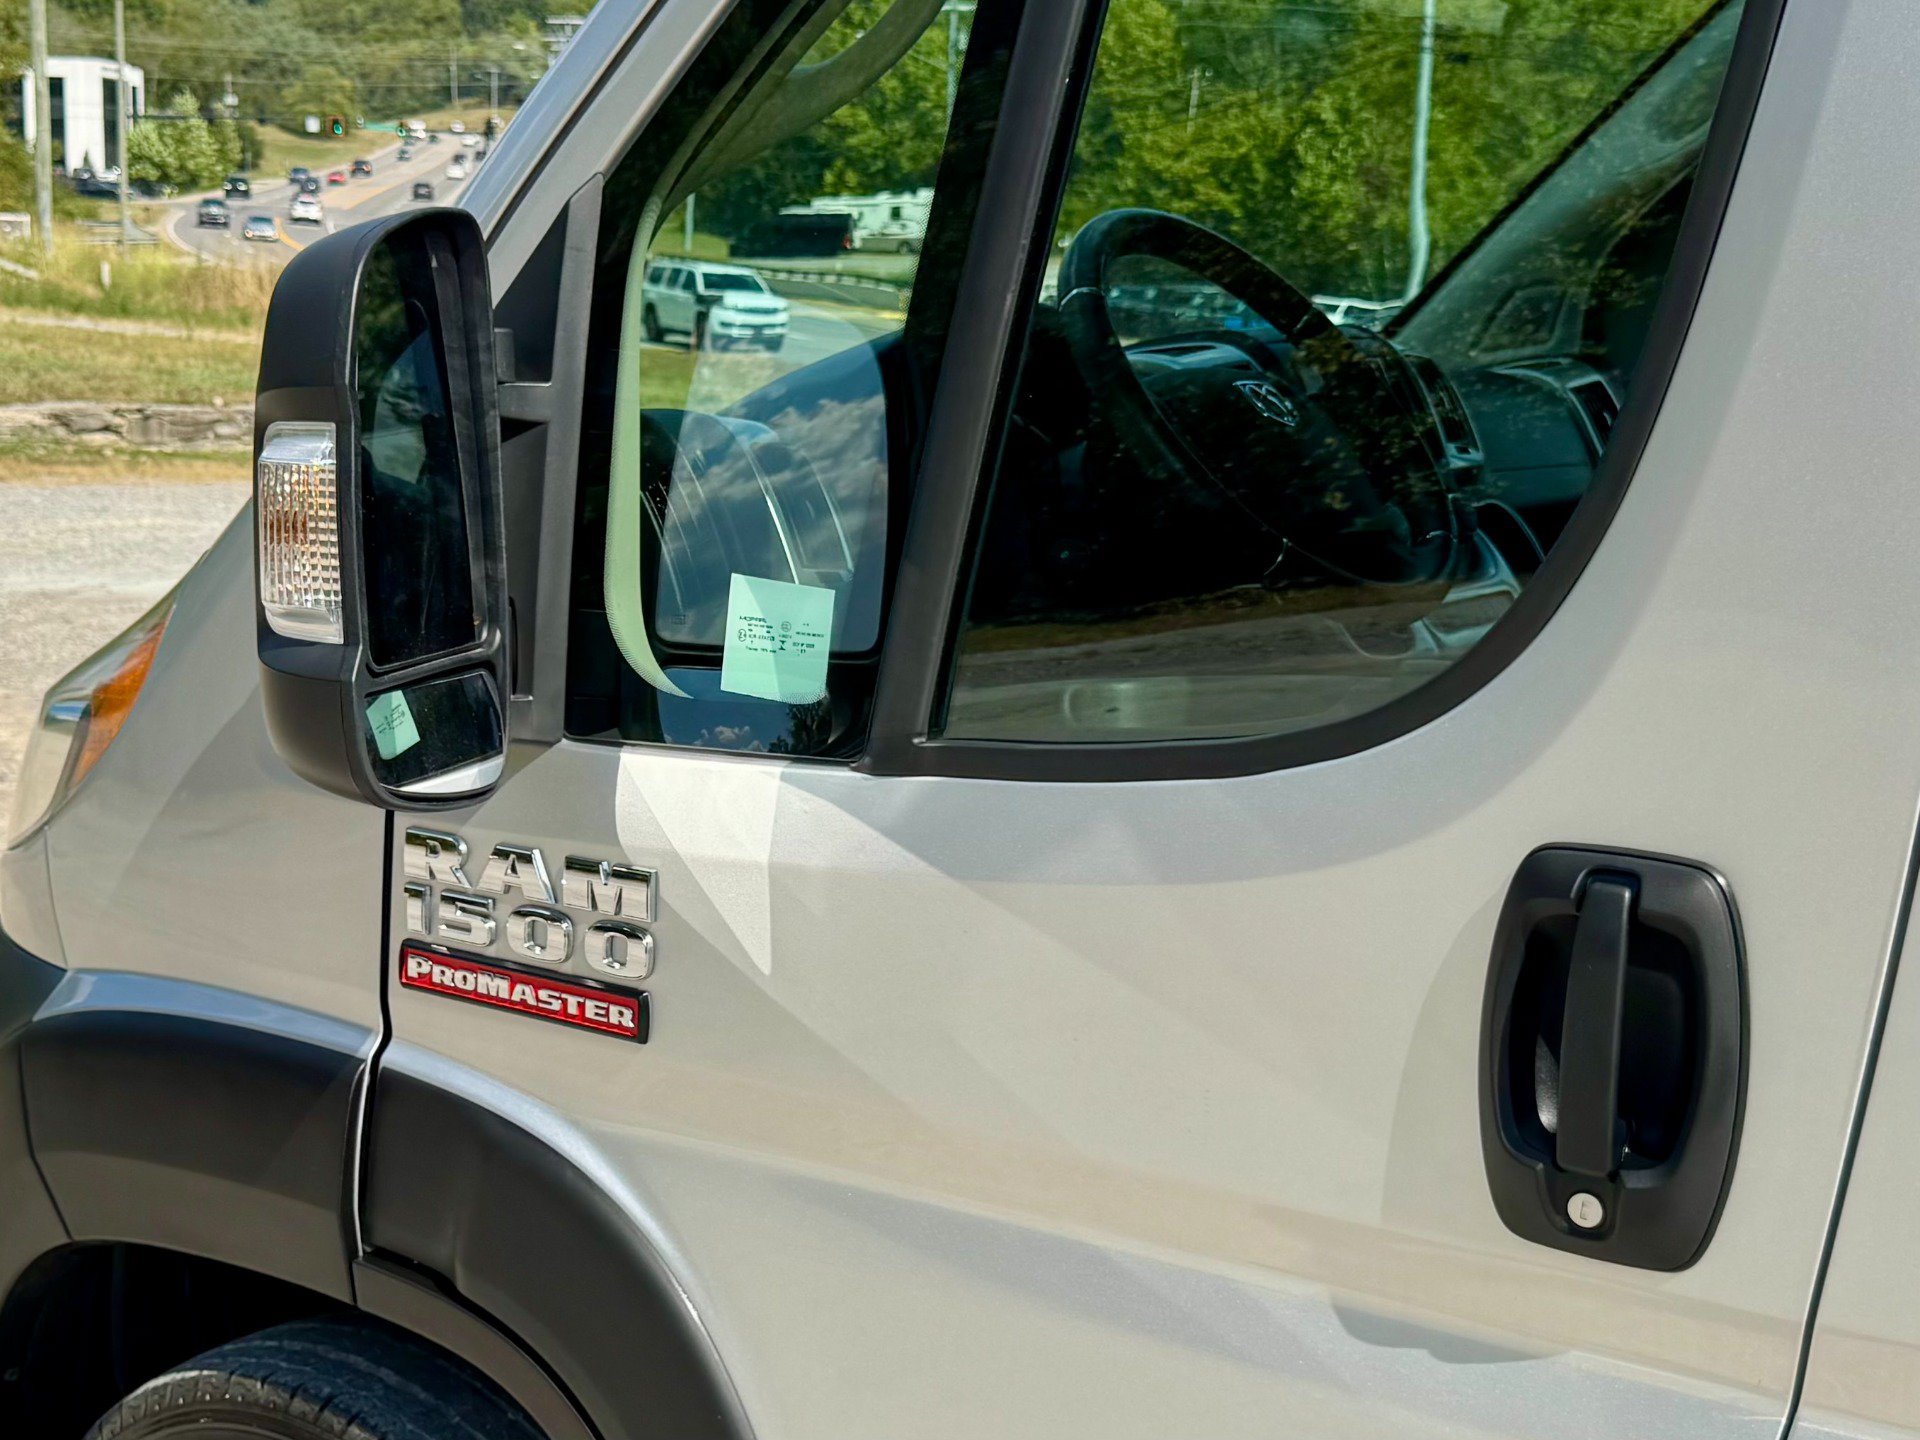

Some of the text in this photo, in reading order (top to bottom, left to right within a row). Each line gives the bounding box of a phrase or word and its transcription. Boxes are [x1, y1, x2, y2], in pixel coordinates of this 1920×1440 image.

[404, 826, 657, 922] RAM
[404, 882, 655, 980] 1500
[407, 954, 635, 1028] PROMASTER
